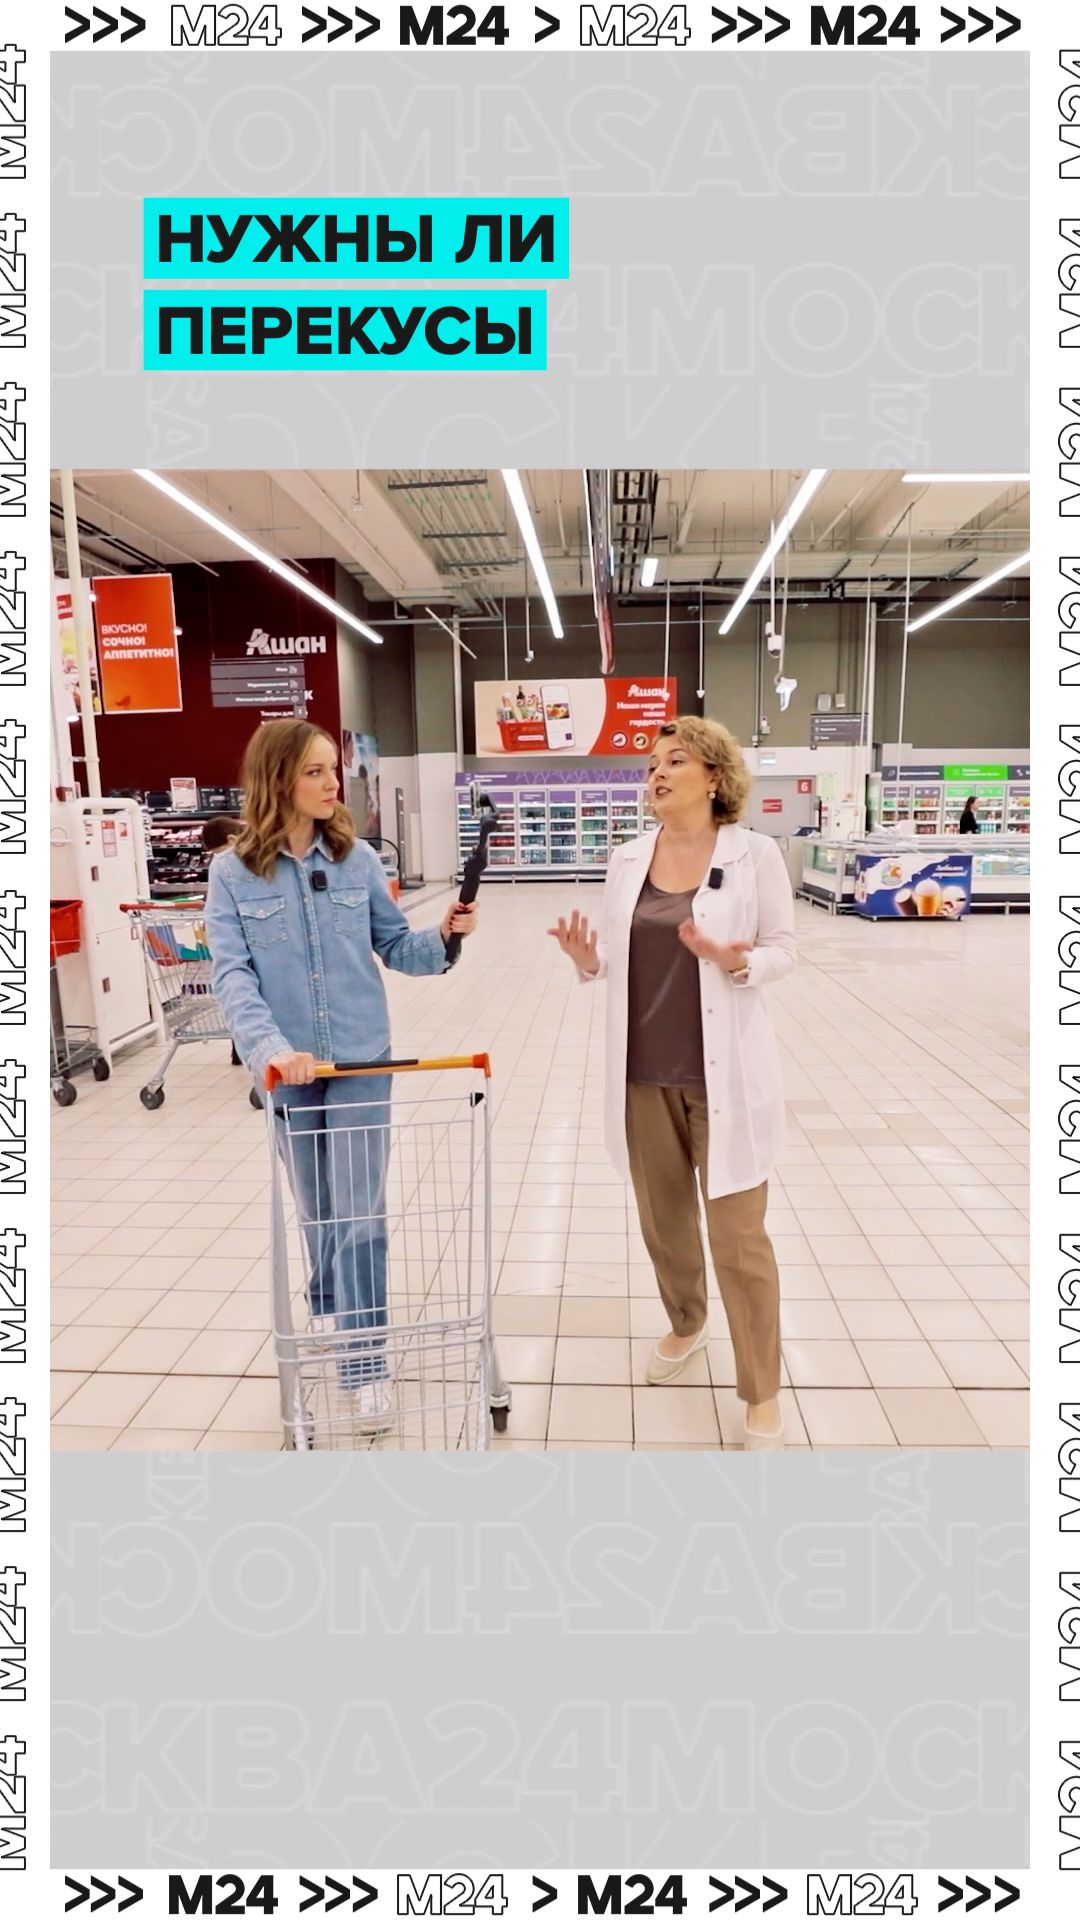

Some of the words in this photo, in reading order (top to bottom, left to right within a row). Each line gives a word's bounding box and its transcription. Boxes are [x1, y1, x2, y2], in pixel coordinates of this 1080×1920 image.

[101, 623, 148, 634] ВКУСНО!
[102, 636, 146, 646] СОЧНО!
[246, 628, 327, 656] Ашан
[103, 647, 175, 660] АППЕТИТНО!
[800, 782, 808, 792] 6
